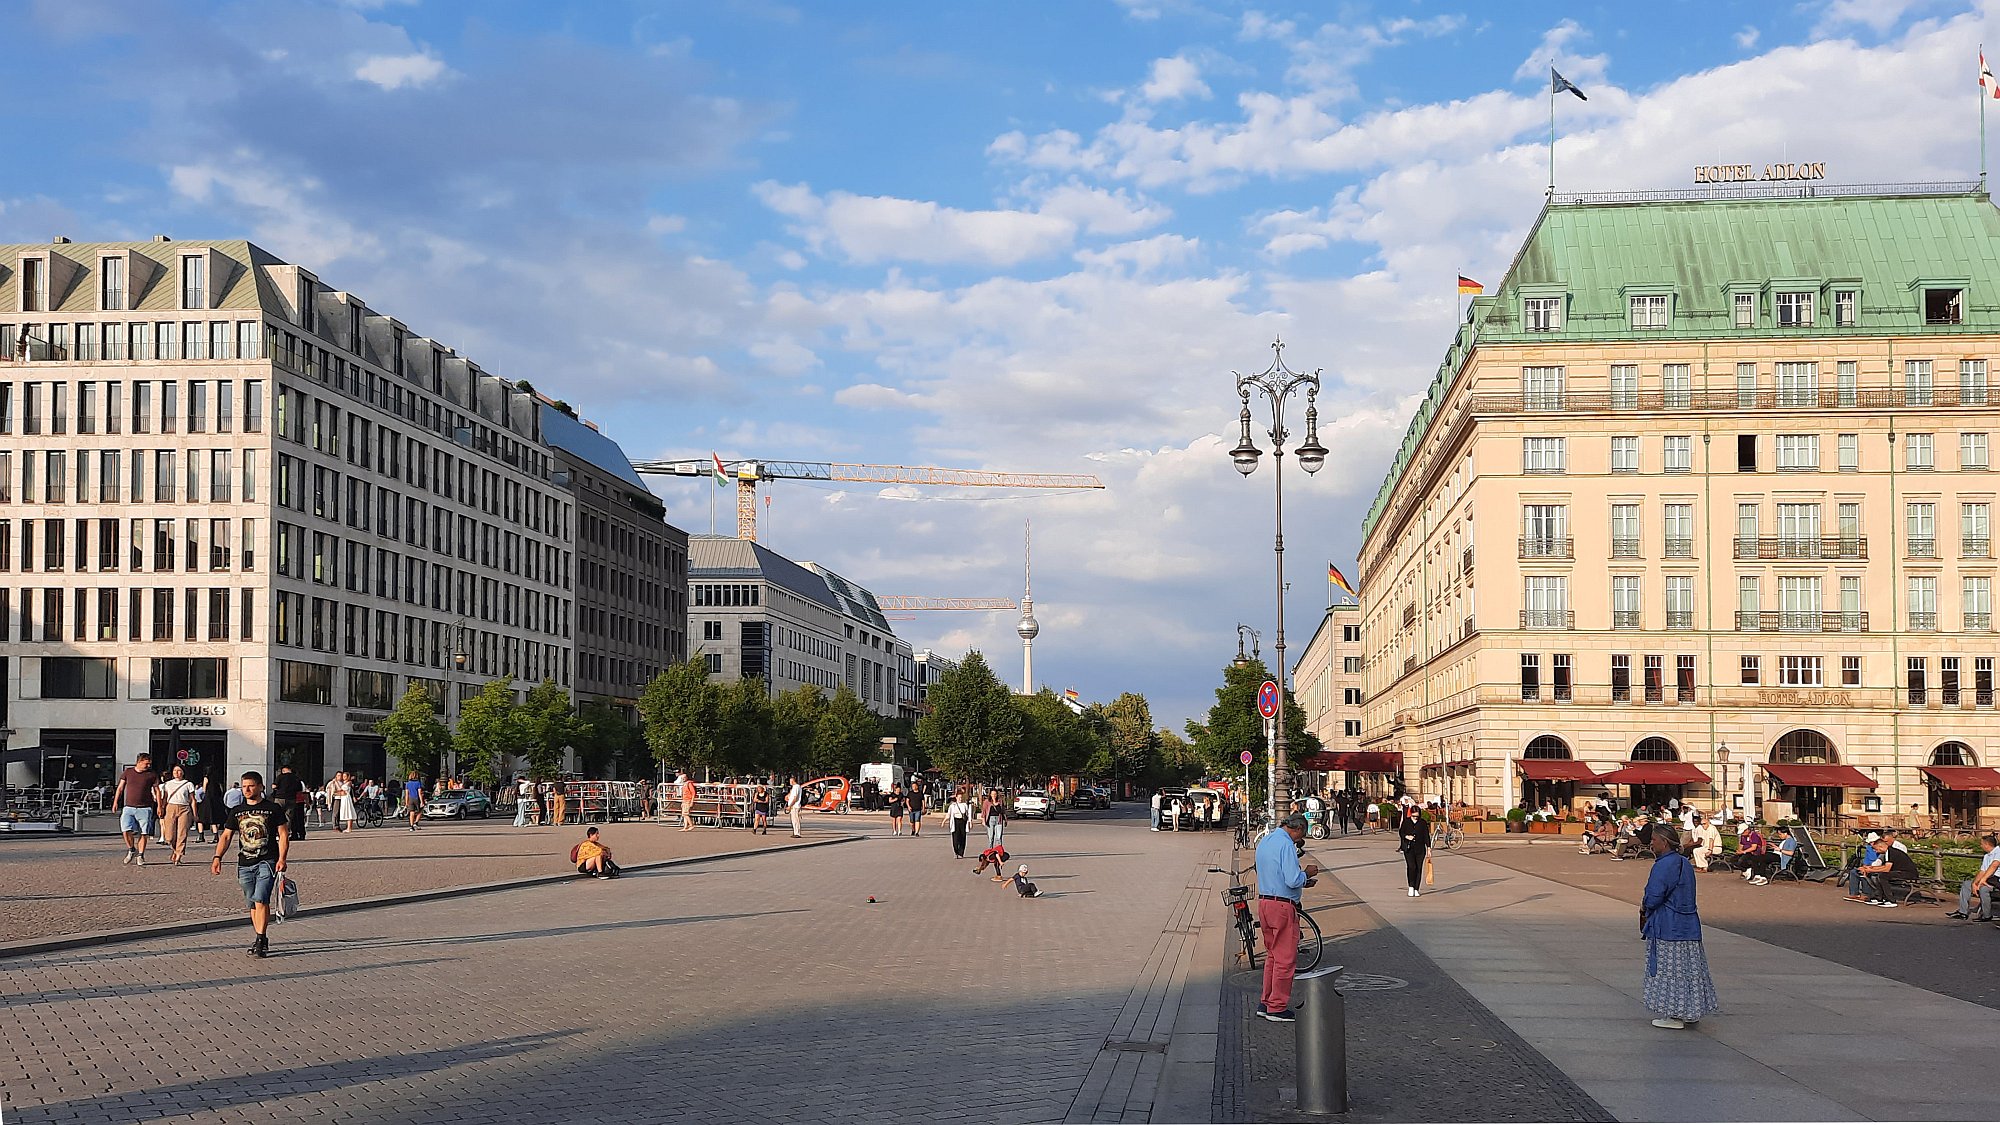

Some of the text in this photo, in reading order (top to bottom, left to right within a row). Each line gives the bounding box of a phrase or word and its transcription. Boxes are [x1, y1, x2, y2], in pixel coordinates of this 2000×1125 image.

[1694, 162, 1826, 183] HOTEL ADLON
[1758, 690, 1852, 706] HOTEL ADLON
[150, 704, 227, 716] STARBUCKS
[163, 716, 212, 727] COFFEE
